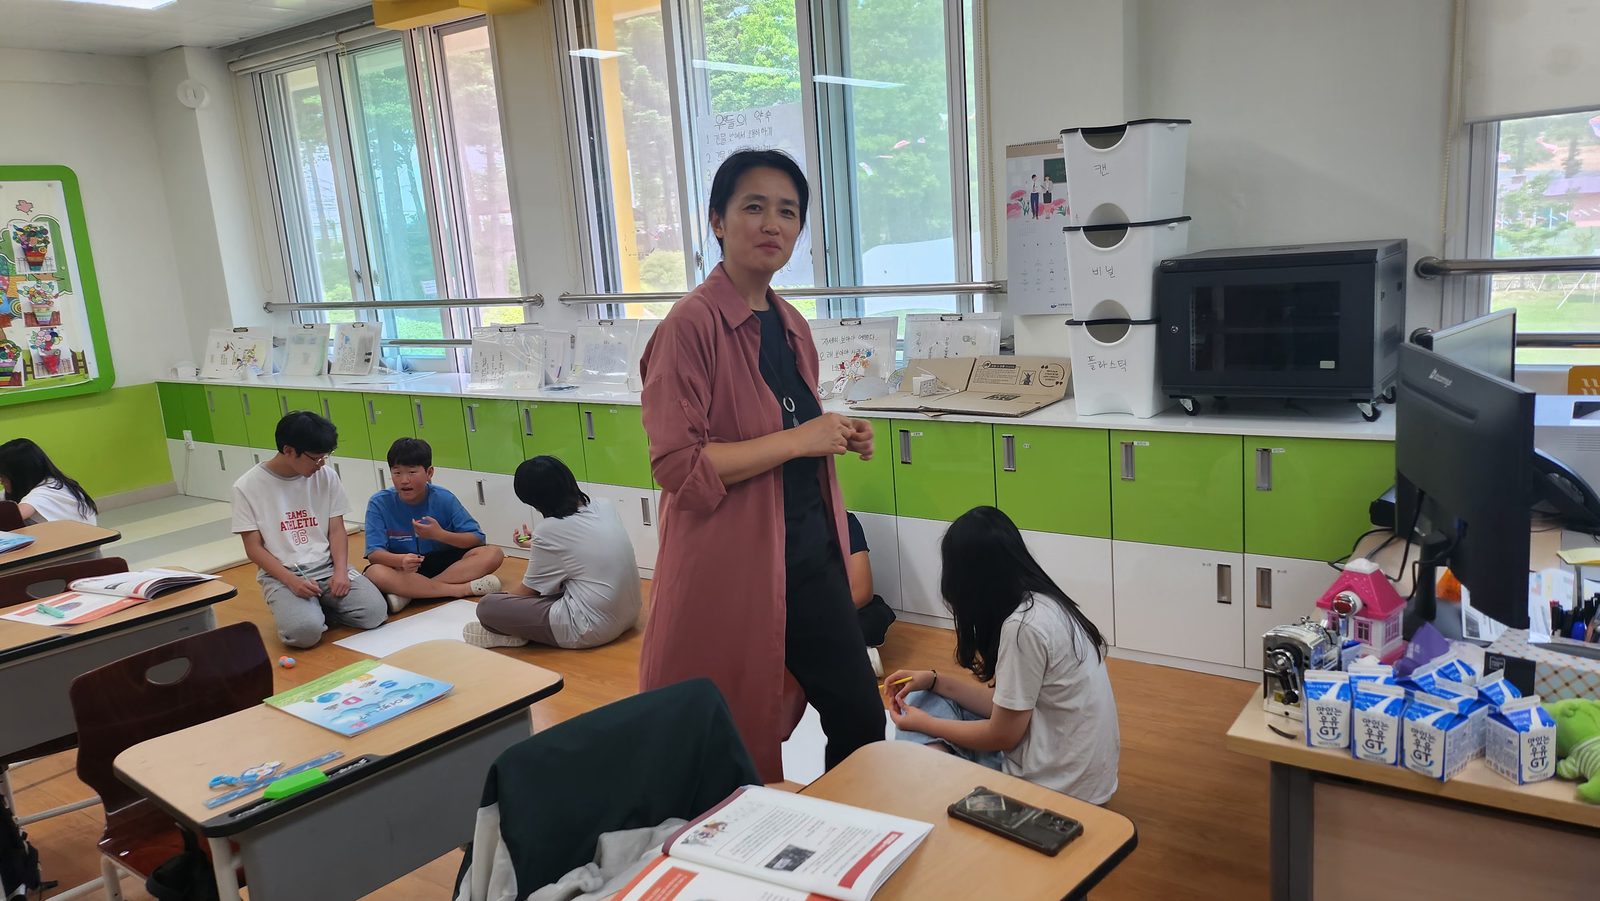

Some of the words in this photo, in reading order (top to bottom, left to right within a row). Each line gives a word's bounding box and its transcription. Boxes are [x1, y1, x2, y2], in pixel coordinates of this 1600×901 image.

[1091, 265, 1116, 279] 비닐
[1088, 355, 1127, 372] 플라스틱
[1316, 706, 1342, 716] 맛있는
[1319, 715, 1340, 726] 우유
[1362, 718, 1389, 731] 맛있는
[1319, 726, 1339, 736] GT
[1364, 728, 1386, 740] 우유
[1411, 727, 1436, 744] 맛있는
[1365, 739, 1384, 751] GT
[1412, 739, 1432, 753] 우유
[1527, 735, 1550, 748] 맛있는
[1413, 749, 1431, 762] GT
[1531, 745, 1547, 757] 우유
[1530, 756, 1547, 768] GT
